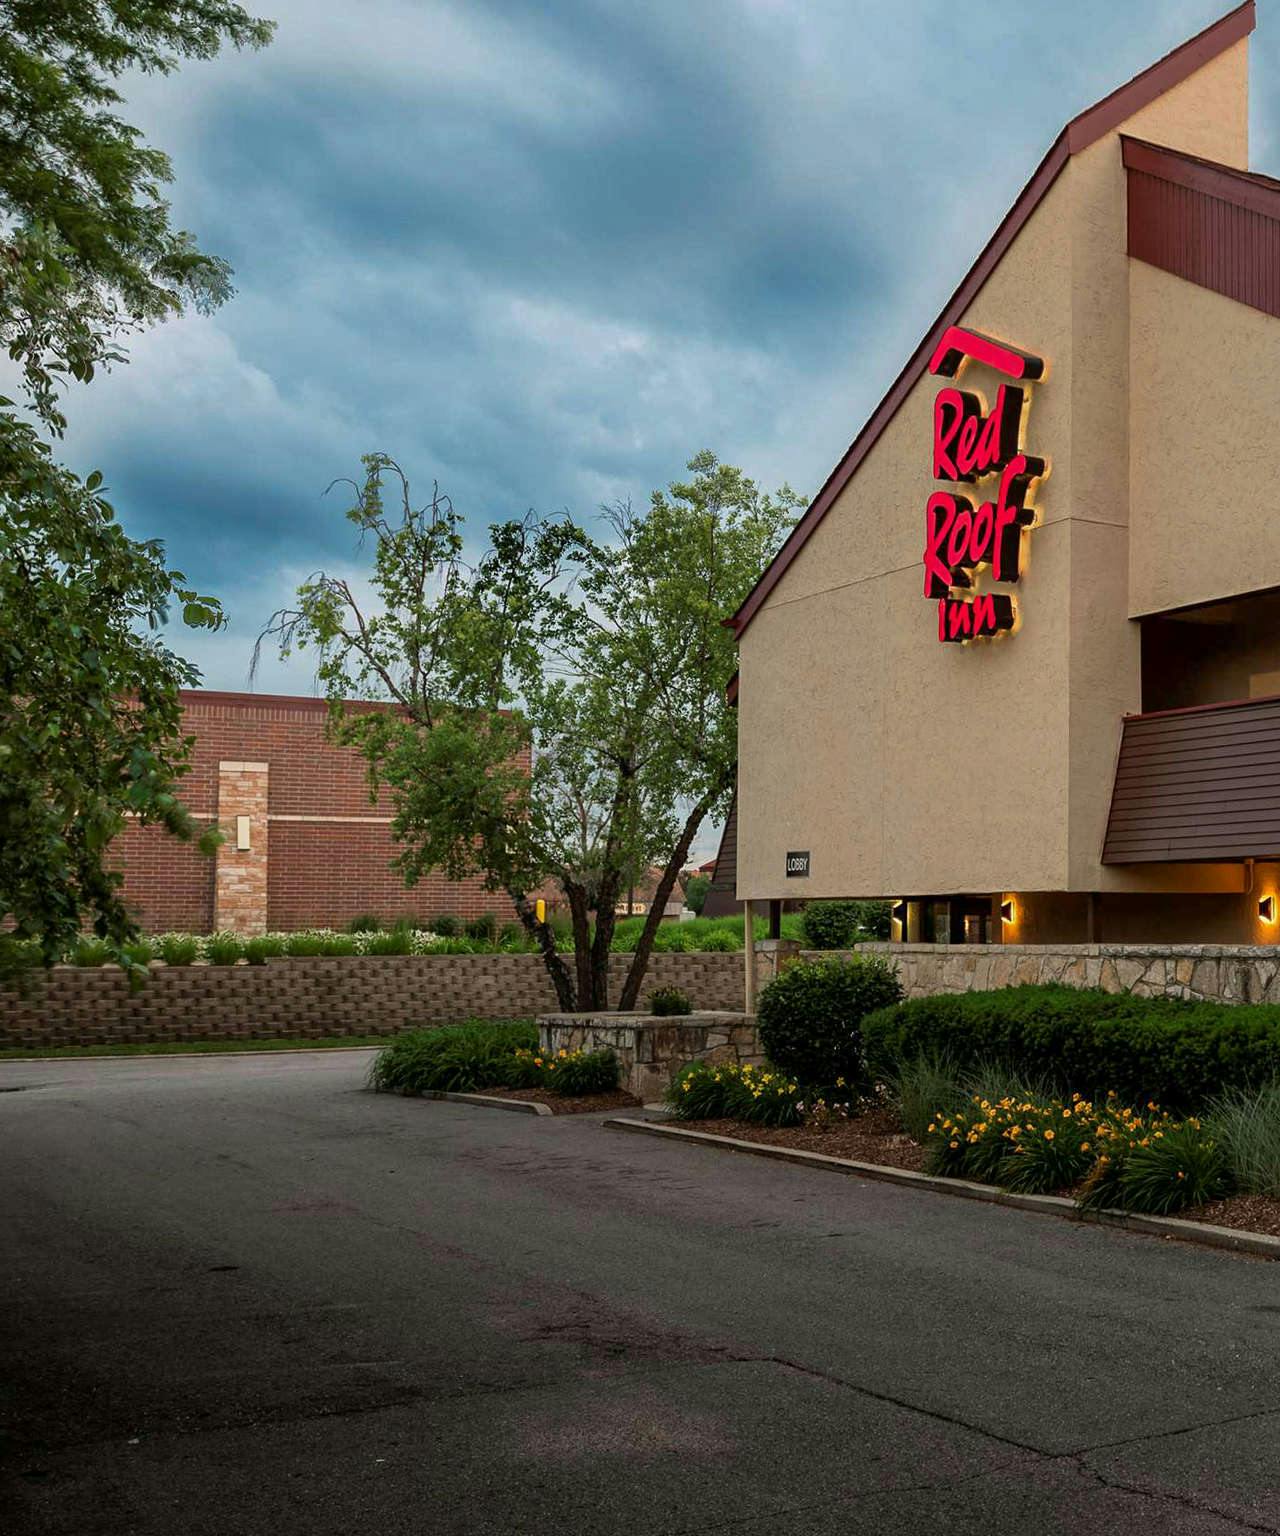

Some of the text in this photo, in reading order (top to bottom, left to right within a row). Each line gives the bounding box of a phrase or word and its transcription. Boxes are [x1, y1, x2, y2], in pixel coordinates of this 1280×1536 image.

[933, 383, 1006, 481] Red
[924, 454, 1026, 599] Roof
[938, 592, 997, 643] Inn
[787, 857, 808, 871] LOBBY
